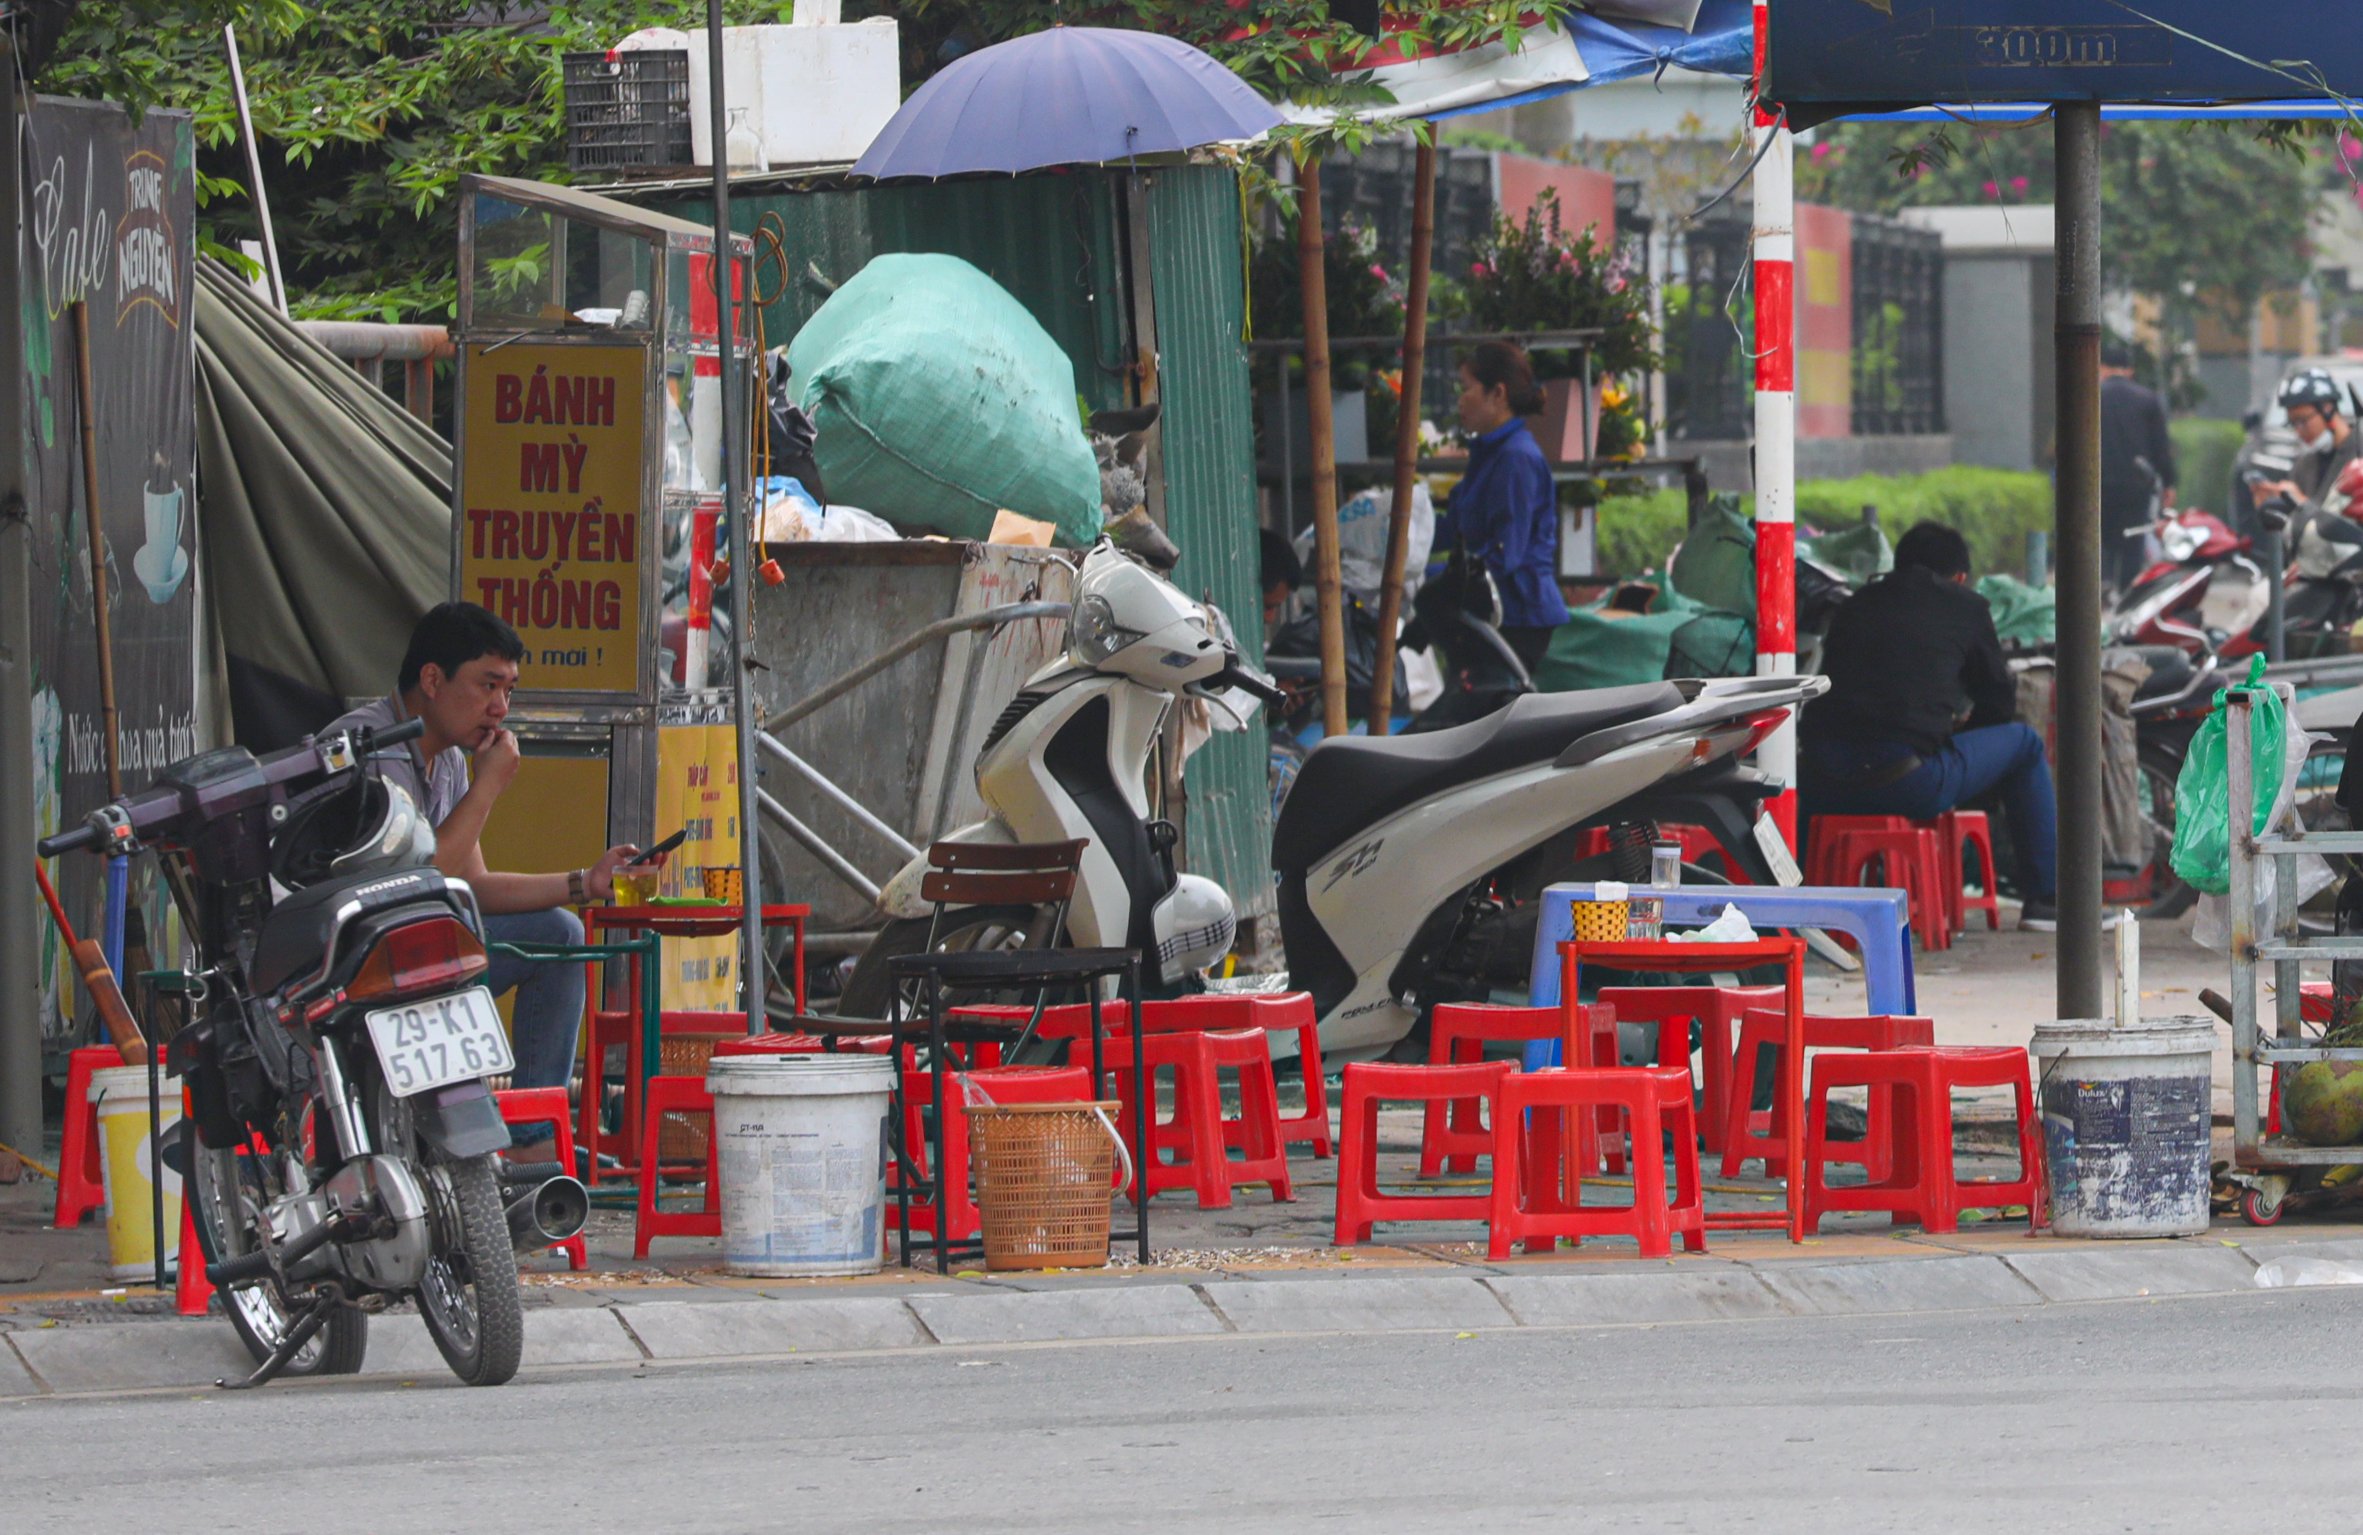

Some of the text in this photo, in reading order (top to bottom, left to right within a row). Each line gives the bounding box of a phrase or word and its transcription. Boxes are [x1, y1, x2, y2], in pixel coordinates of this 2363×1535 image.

[129, 168, 162, 214] TRUNG
[495, 364, 615, 426] BÁNH
[520, 433, 588, 494] MỲ
[467, 495, 634, 563] TRUYỀN
[478, 562, 621, 631] THỐNG
[118, 710, 142, 771] hoa
[144, 704, 166, 782] quả
[356, 875, 422, 896] HONDA
[388, 996, 479, 1048] 29-K1
[390, 1032, 503, 1090] 517.63
[2078, 1088, 2106, 1098] Dulux
